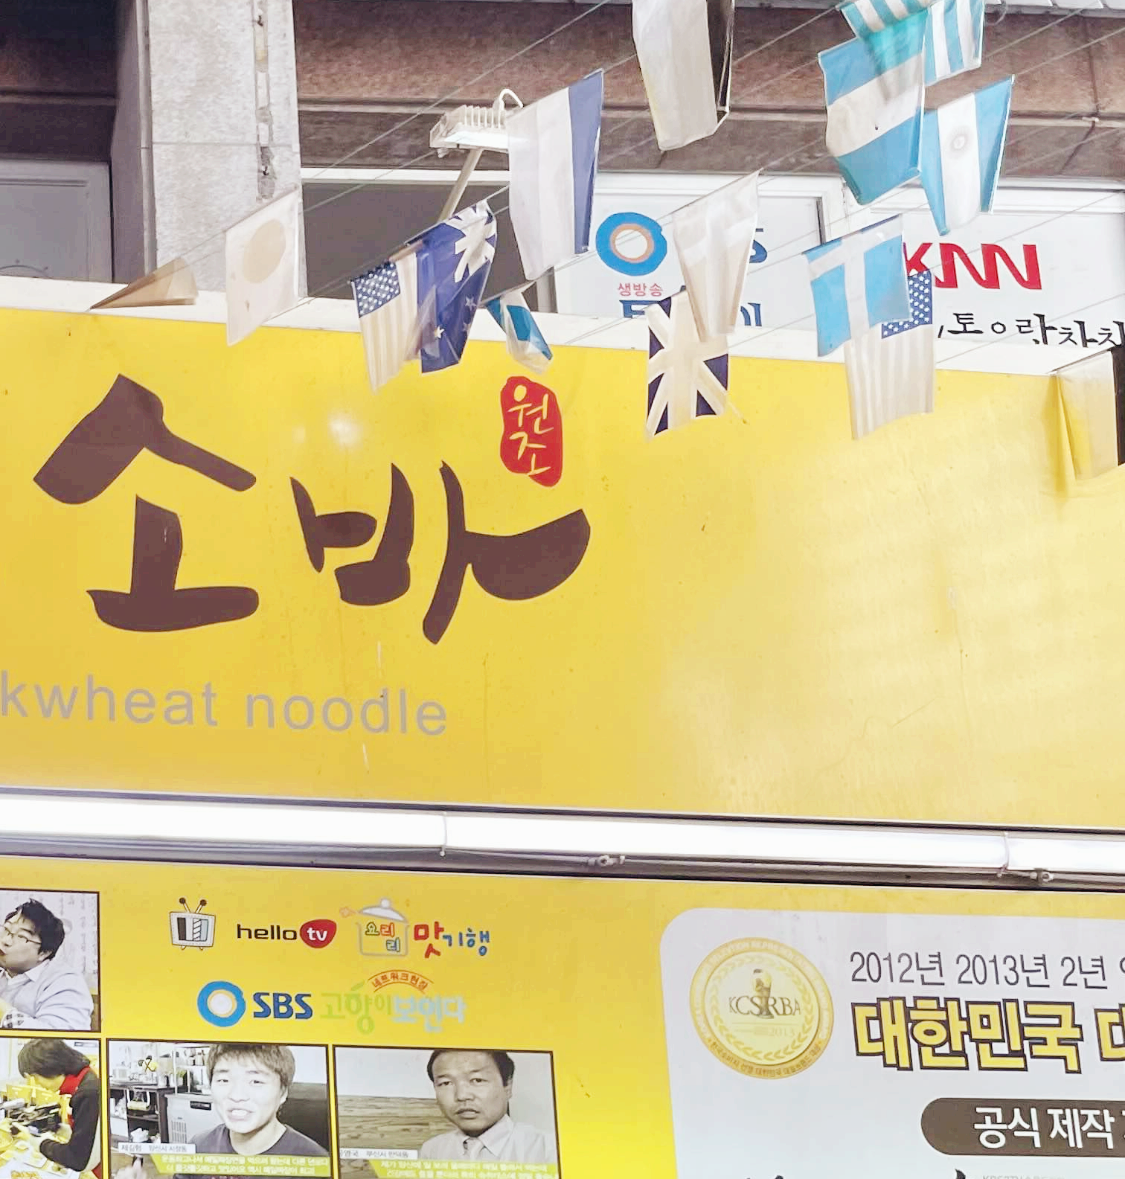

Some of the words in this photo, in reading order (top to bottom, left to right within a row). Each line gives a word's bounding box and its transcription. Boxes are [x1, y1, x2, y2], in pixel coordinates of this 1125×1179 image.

[904, 242, 1043, 290] KNN
[617, 282, 663, 297] 생방송
[507, 384, 555, 476] 원조
[244, 686, 450, 738] noodle
[236, 924, 298, 941] hello
[306, 927, 328, 942] tv
[850, 951, 946, 986] 2012년
[957, 953, 1051, 989] 2013년
[1061, 955, 1108, 989] 2년
[253, 992, 313, 1020] SBS
[851, 996, 1084, 1075] 대한민국
[974, 1106, 1041, 1148] 공식
